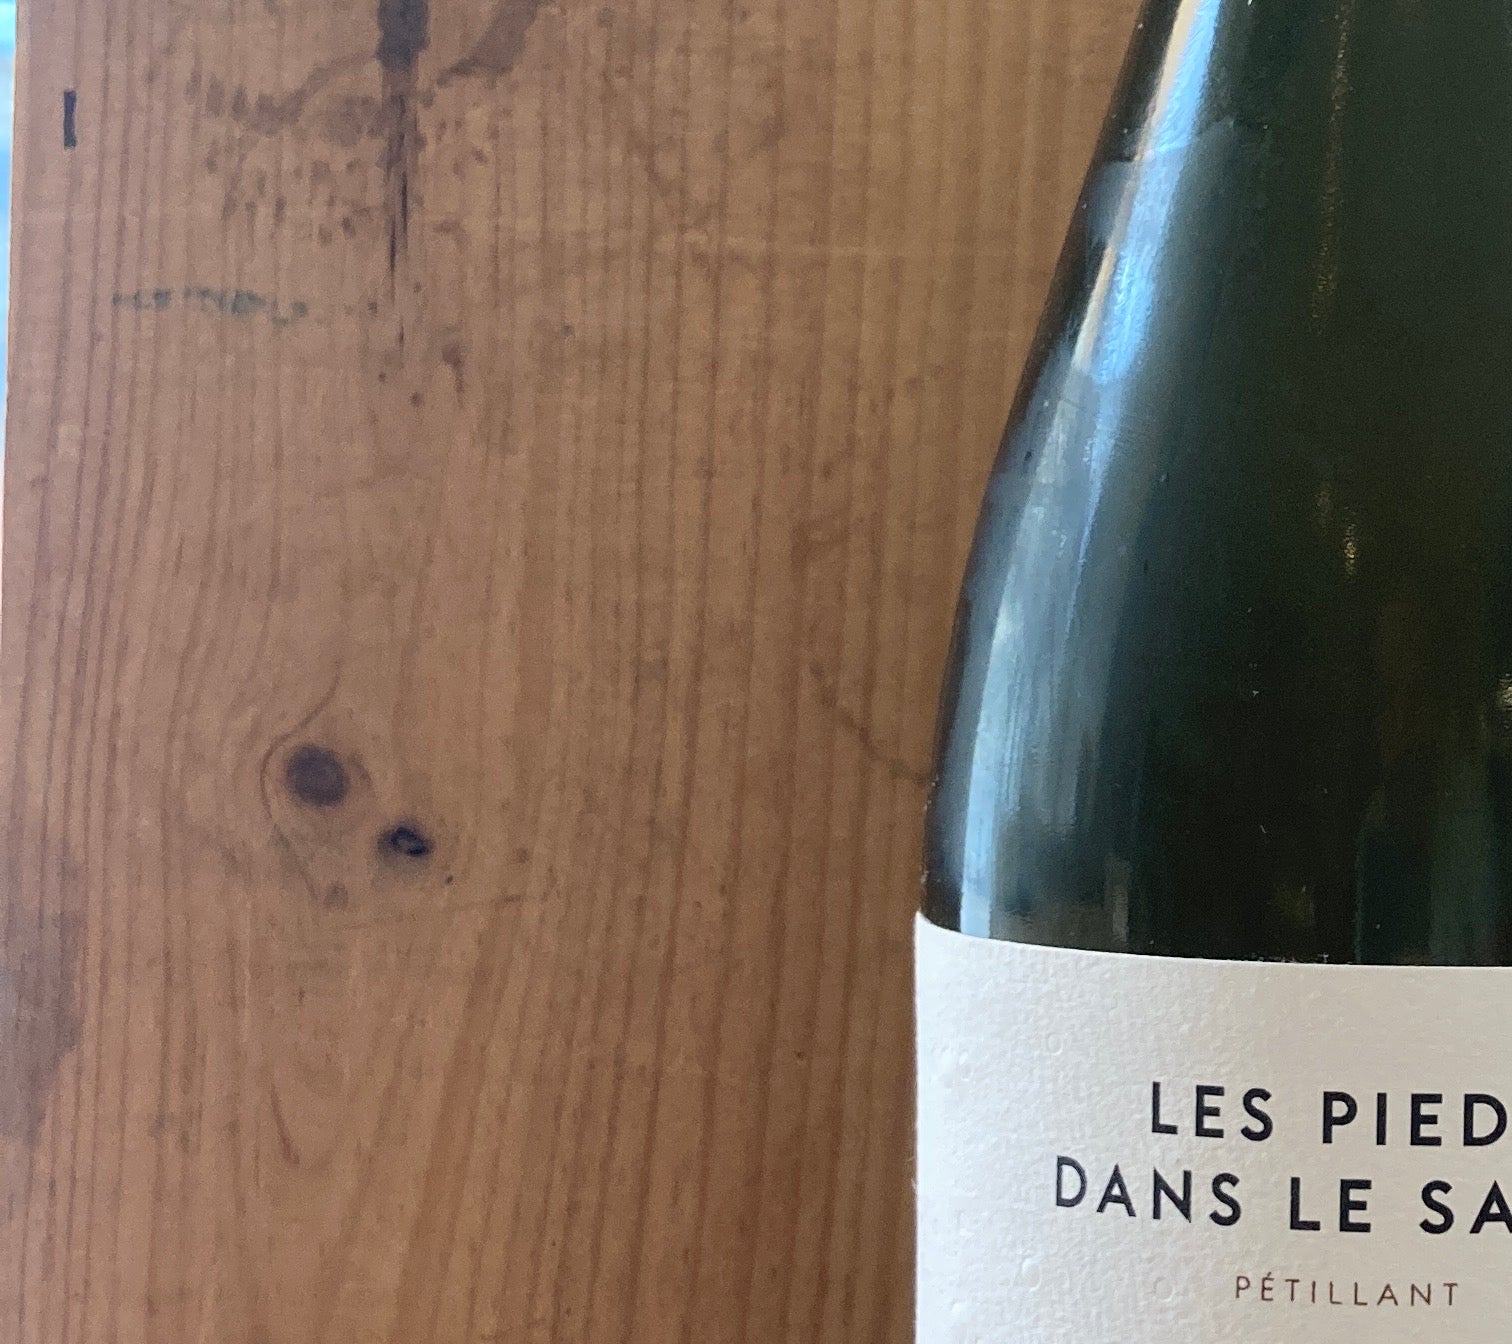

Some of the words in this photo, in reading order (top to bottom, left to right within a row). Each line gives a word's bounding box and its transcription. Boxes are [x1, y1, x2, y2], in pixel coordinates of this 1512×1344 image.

[1150, 1080, 1274, 1143] LES
[1055, 1155, 1243, 1227] DANS
[1289, 1176, 1373, 1234] LE
[1234, 1270, 1459, 1308] PÉTILLANT
